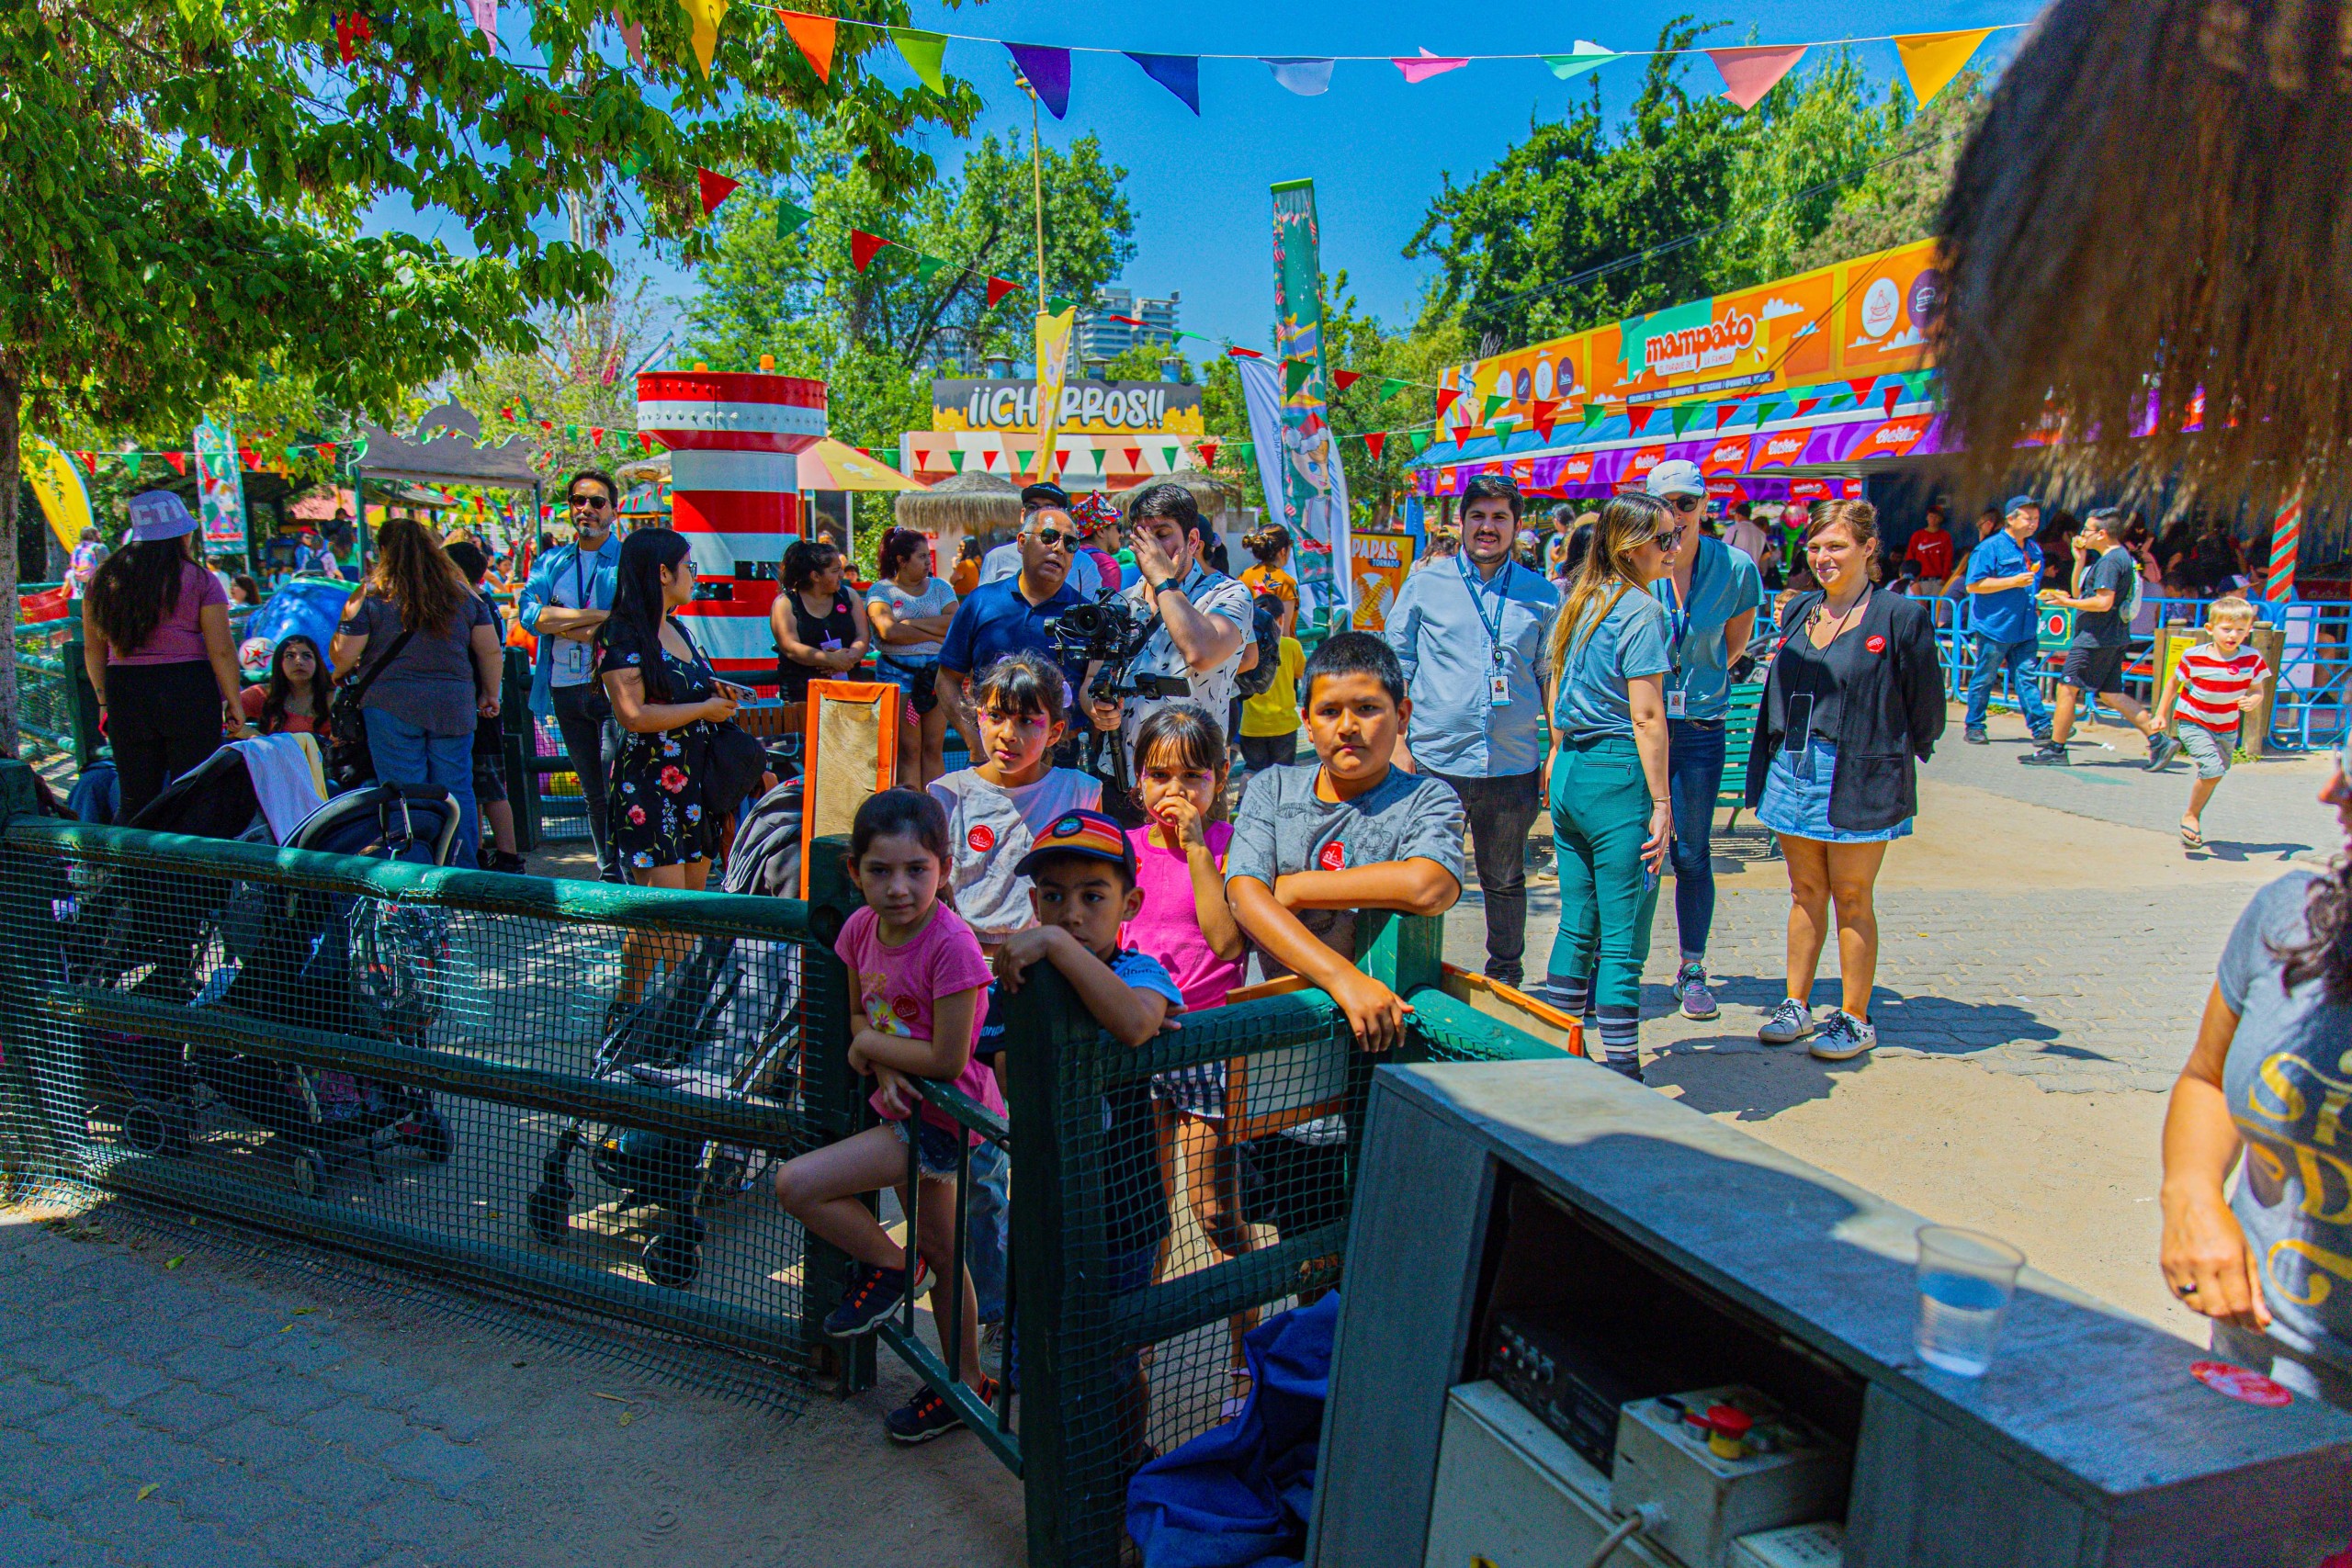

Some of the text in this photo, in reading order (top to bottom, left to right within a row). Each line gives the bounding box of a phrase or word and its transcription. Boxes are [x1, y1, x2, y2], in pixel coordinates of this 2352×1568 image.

[1645, 308, 1755, 369] mampato
[1351, 538, 1398, 559] PAPAS
[1372, 558, 1400, 568] TORNADO
